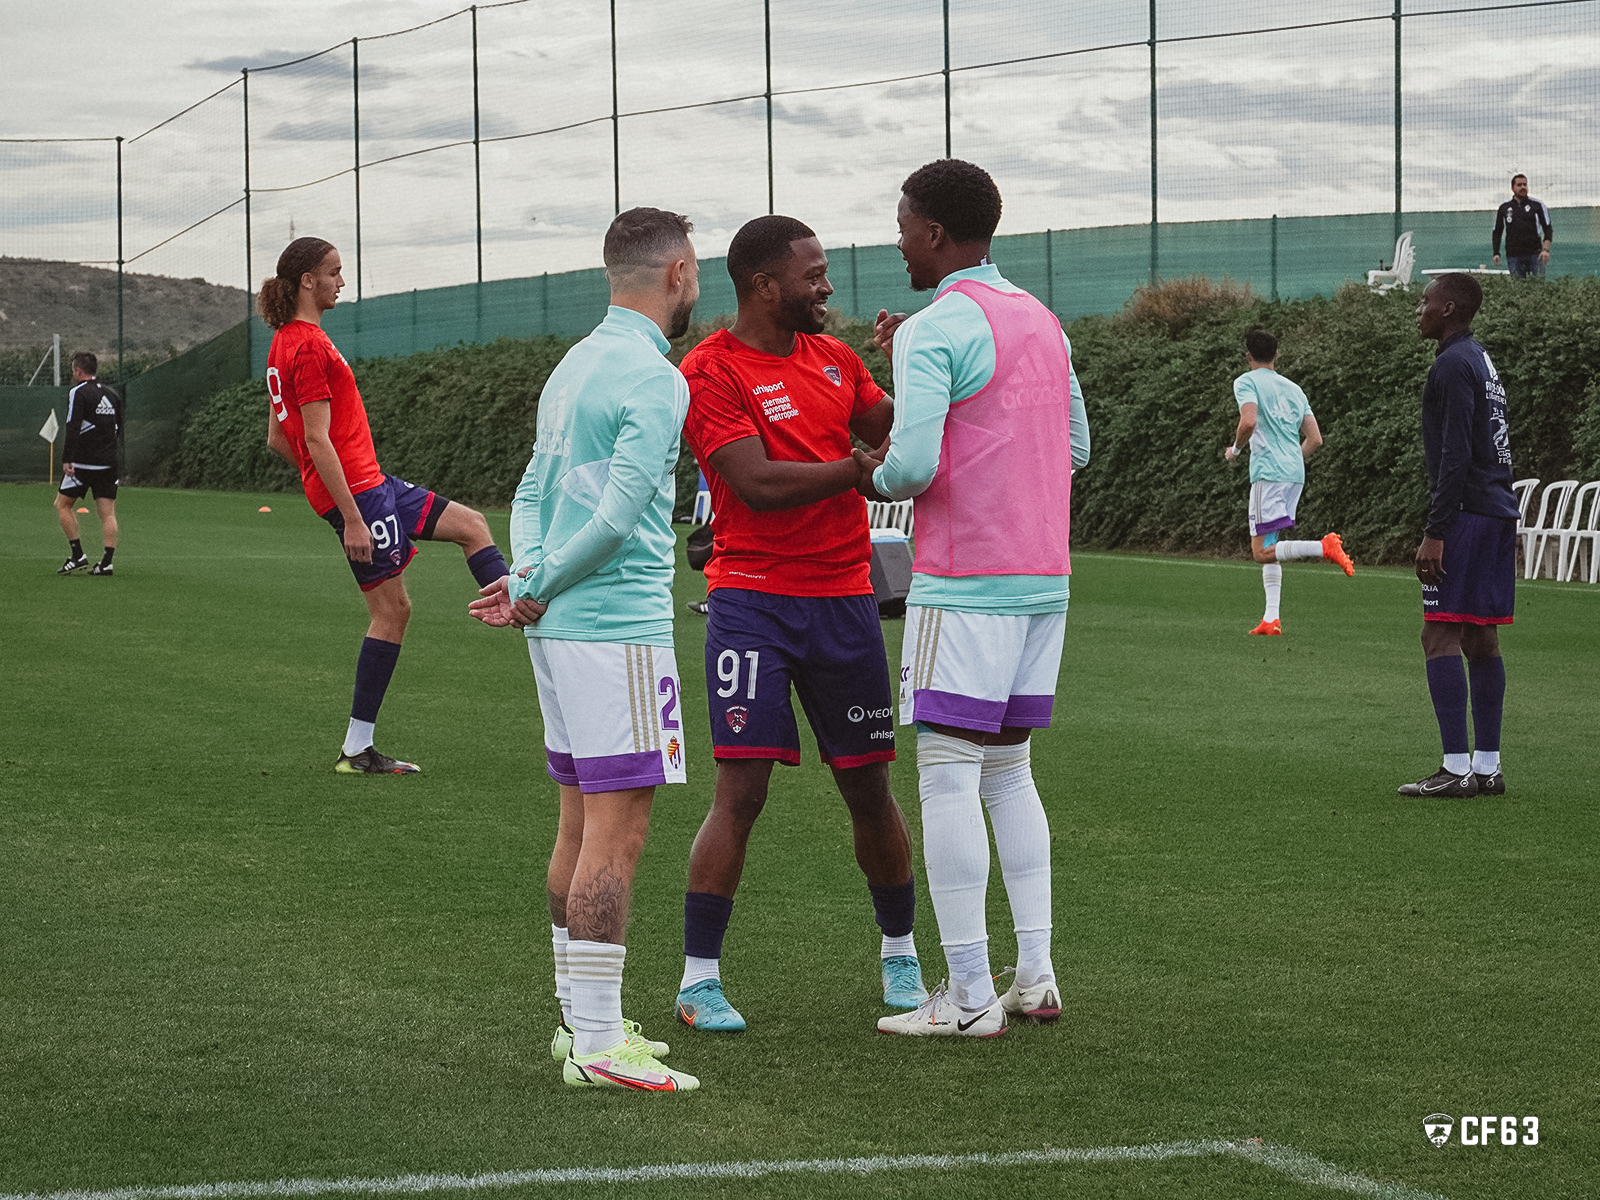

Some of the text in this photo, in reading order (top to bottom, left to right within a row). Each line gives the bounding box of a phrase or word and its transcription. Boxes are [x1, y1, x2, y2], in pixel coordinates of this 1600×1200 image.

[752, 380, 786, 396] uhlsport
[761, 394, 791, 408] clermont
[763, 402, 793, 416] auvergne
[370, 514, 400, 550] 97
[716, 648, 760, 700] 91
